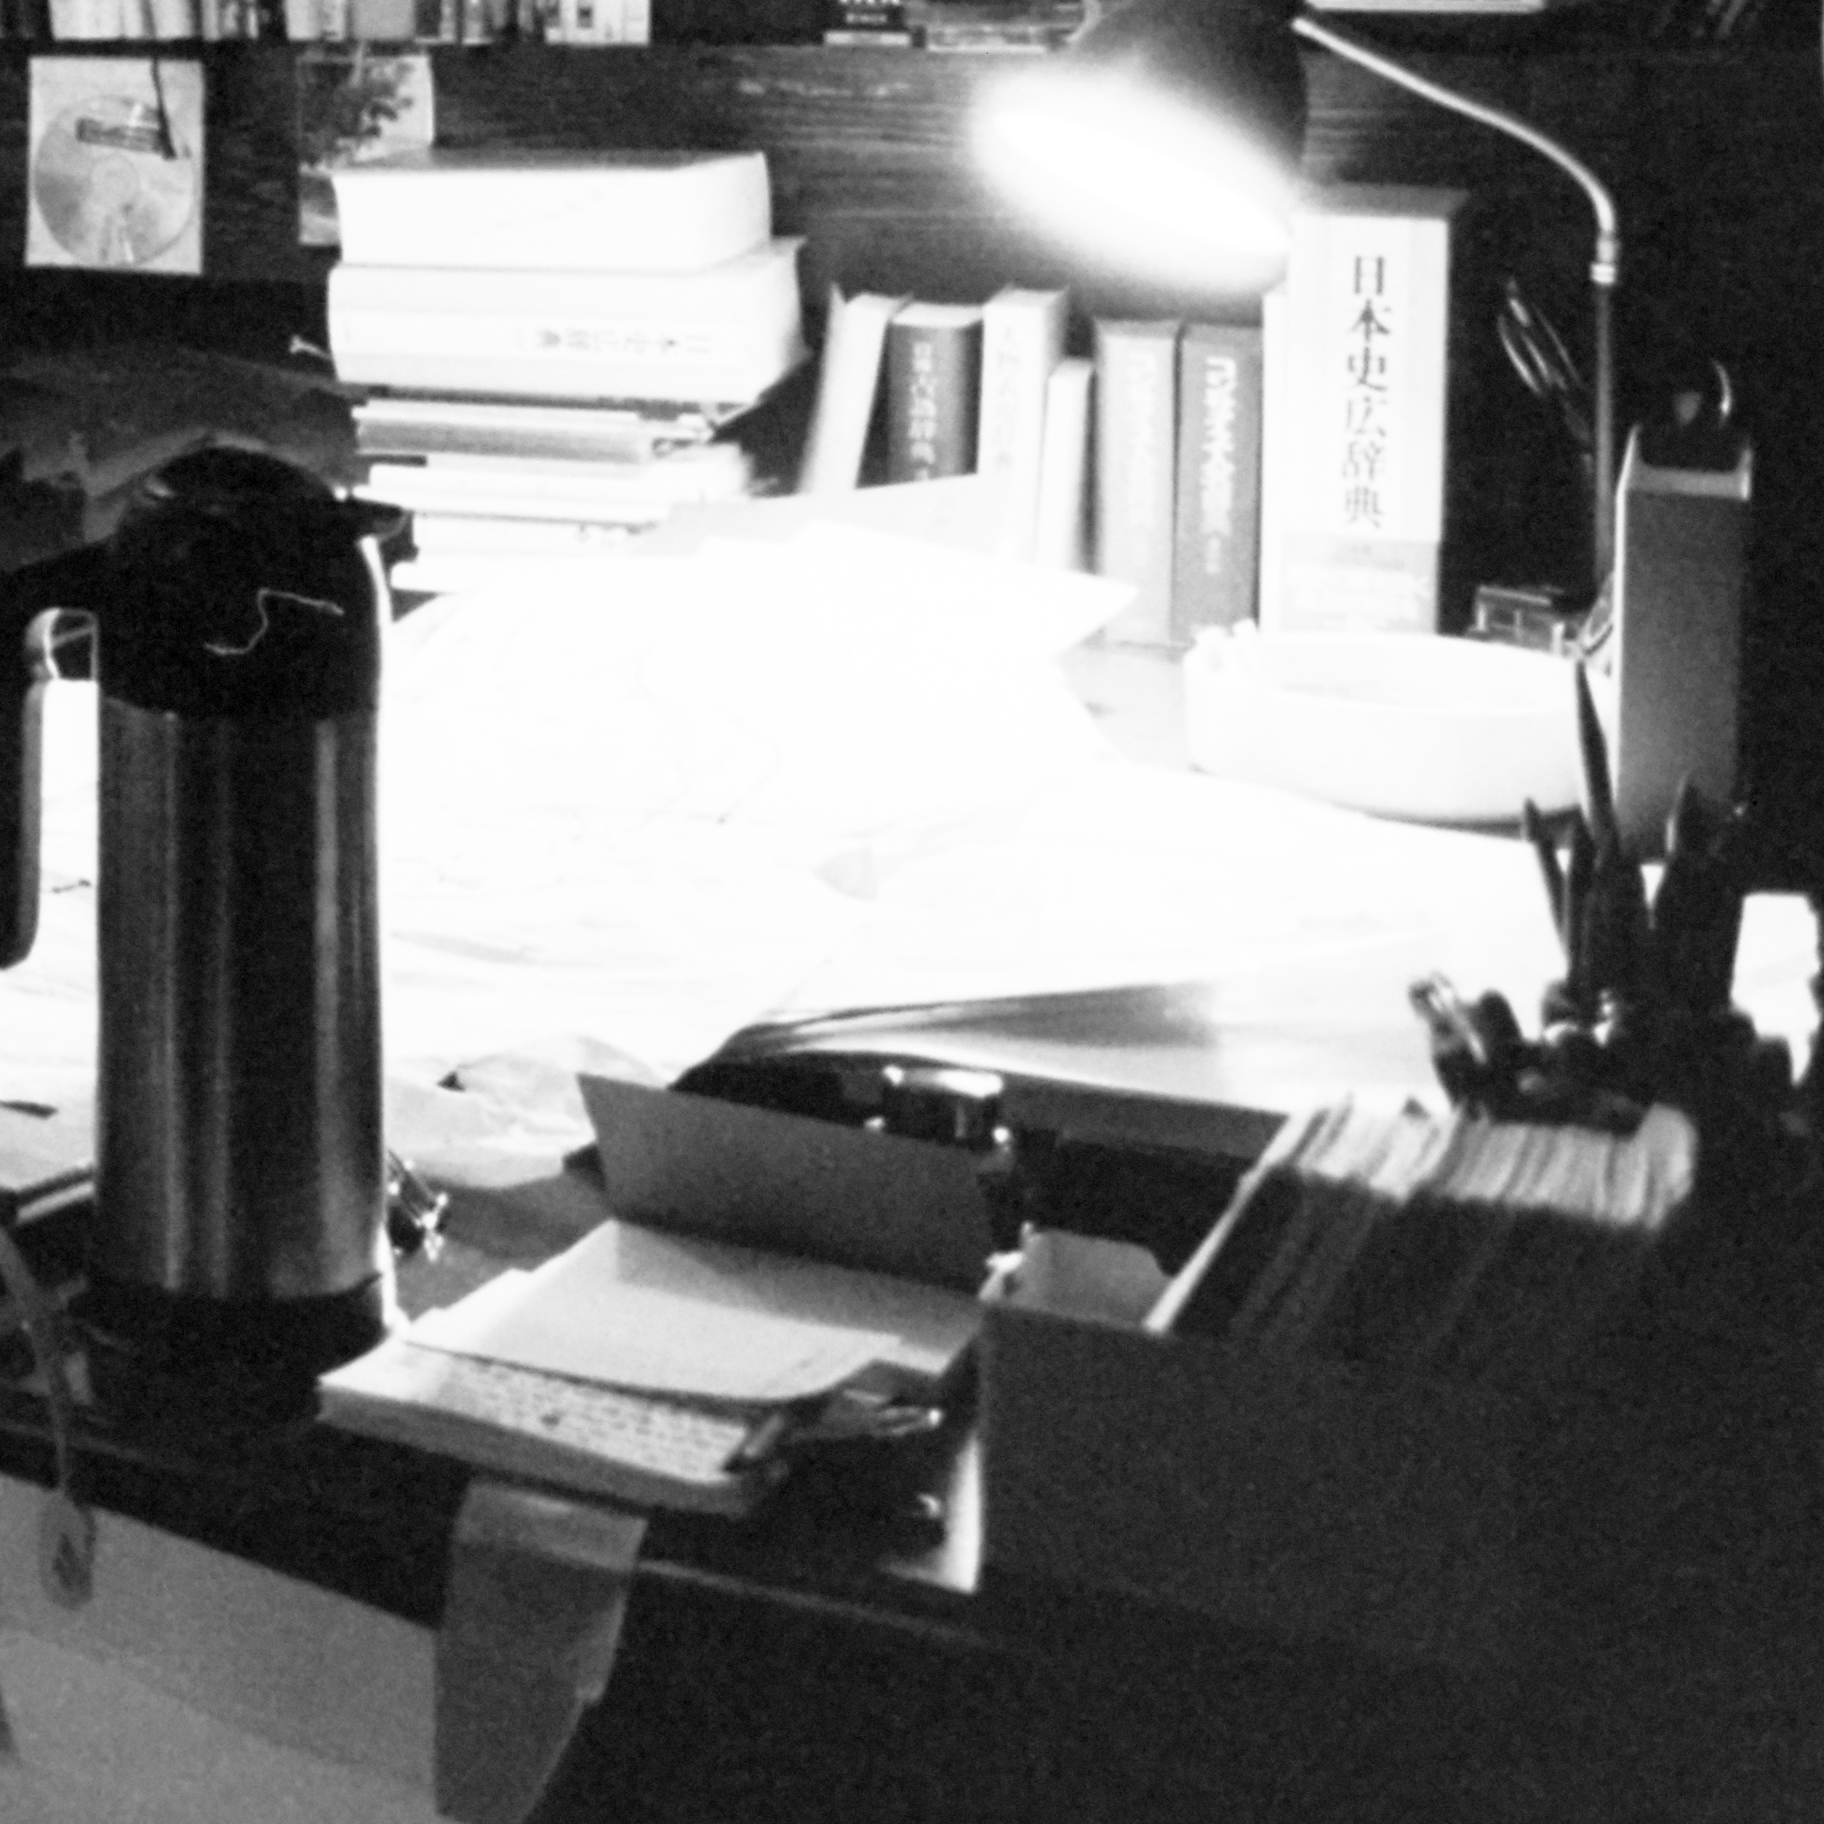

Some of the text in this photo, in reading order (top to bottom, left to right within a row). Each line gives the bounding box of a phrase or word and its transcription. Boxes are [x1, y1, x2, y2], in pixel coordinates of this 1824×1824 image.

[1341, 254, 1393, 530] 日本史広辞典
